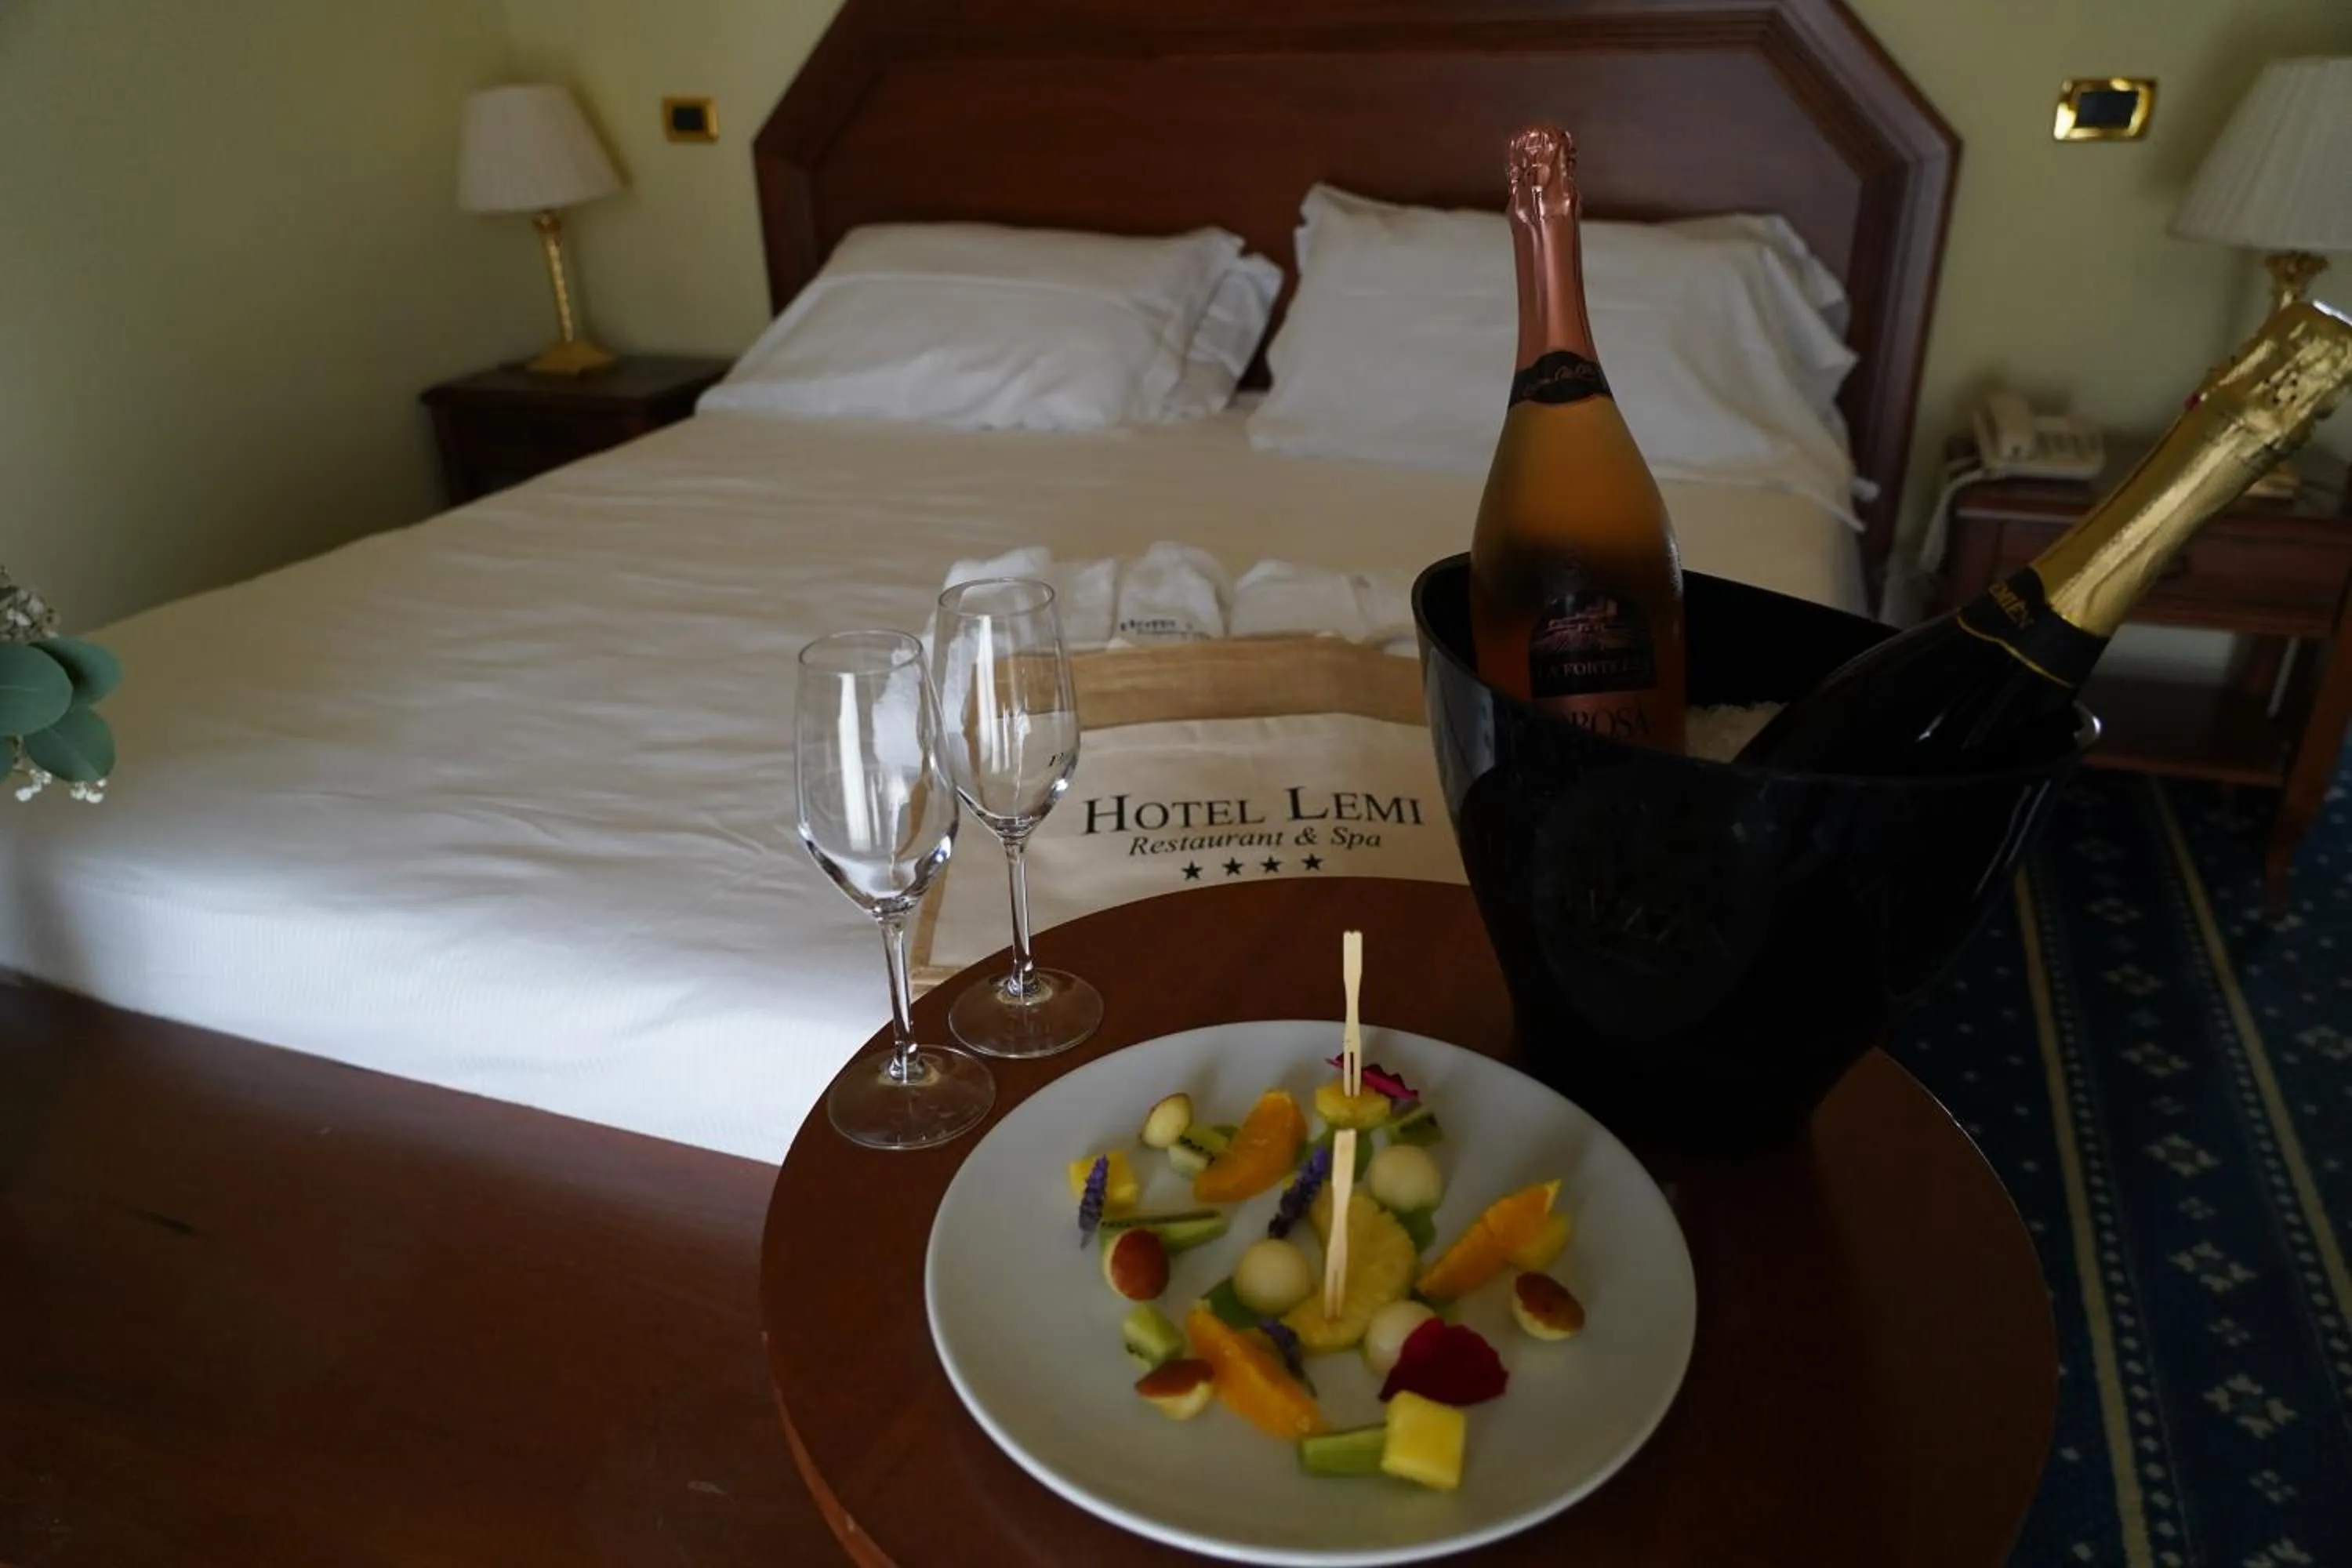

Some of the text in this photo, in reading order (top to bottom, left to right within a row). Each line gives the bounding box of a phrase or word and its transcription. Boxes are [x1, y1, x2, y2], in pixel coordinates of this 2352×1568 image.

[1082, 786, 1425, 834] HOTEL LEMI
[1128, 826, 1382, 856] Restaurant & Spa
